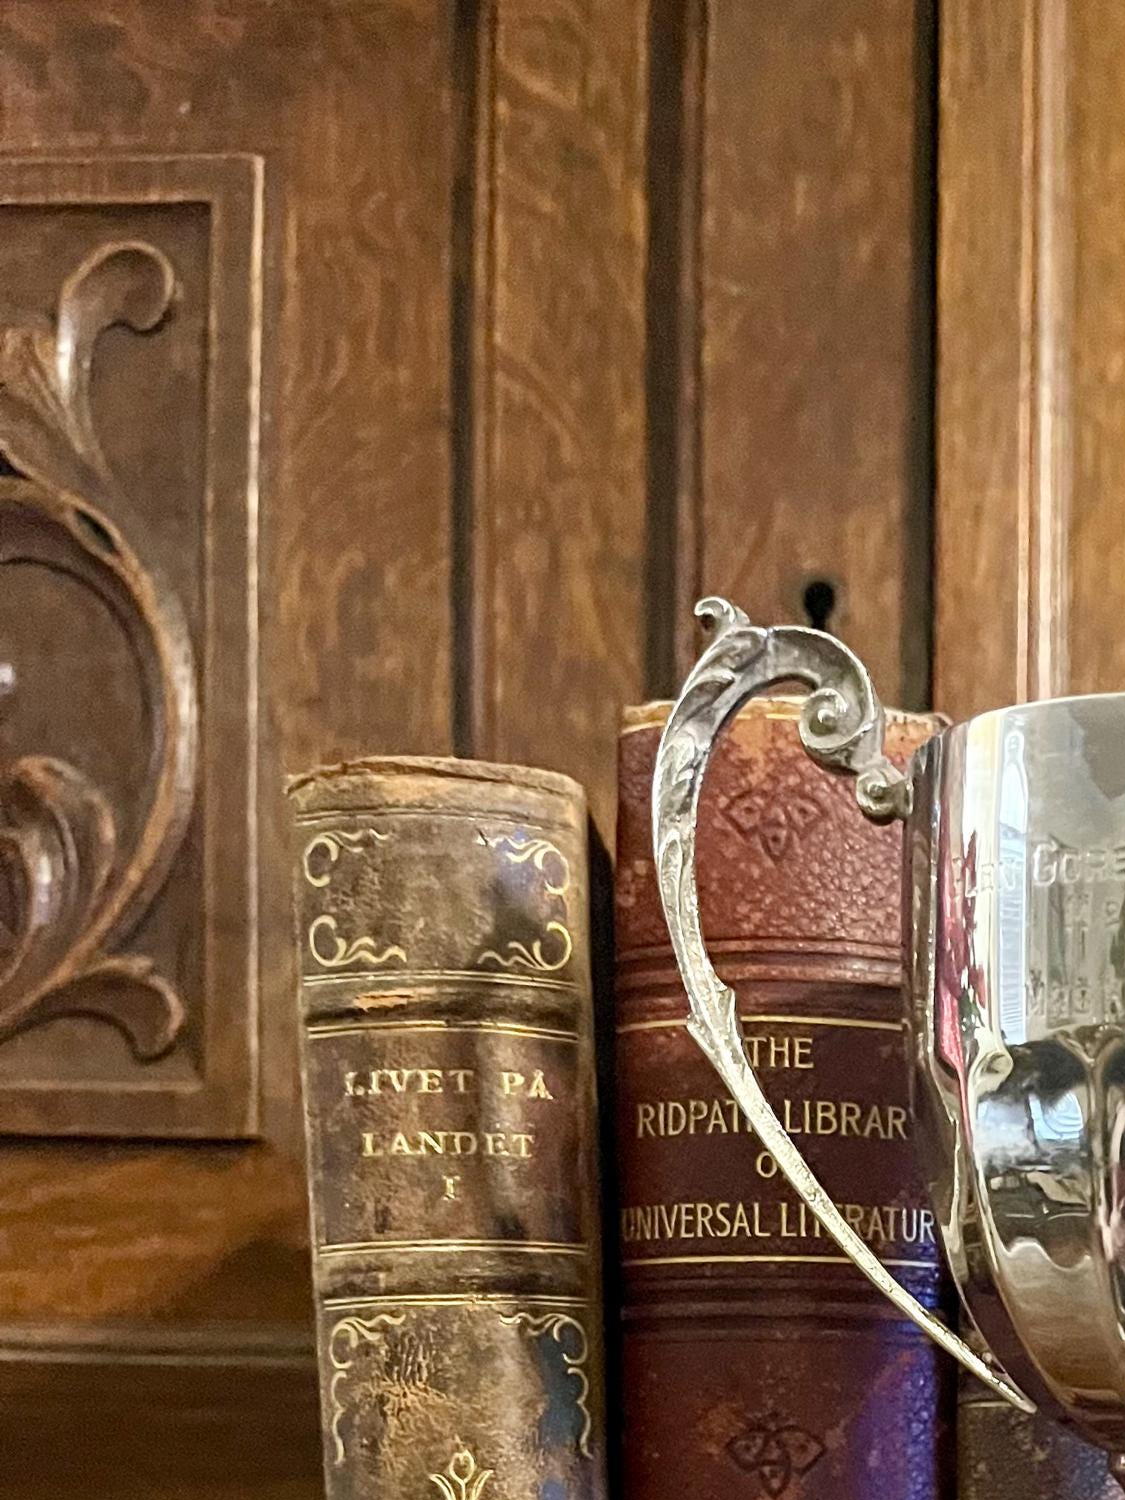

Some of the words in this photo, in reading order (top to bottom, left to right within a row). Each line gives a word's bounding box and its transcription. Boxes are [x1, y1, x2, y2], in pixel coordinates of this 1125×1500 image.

[745, 1036, 815, 1069] THE
[344, 1068, 475, 1096] LIVET
[784, 1100, 910, 1139] LIBRAR
[362, 1131, 535, 1158] LANDET
[622, 1203, 772, 1242] UNIVERSAL
